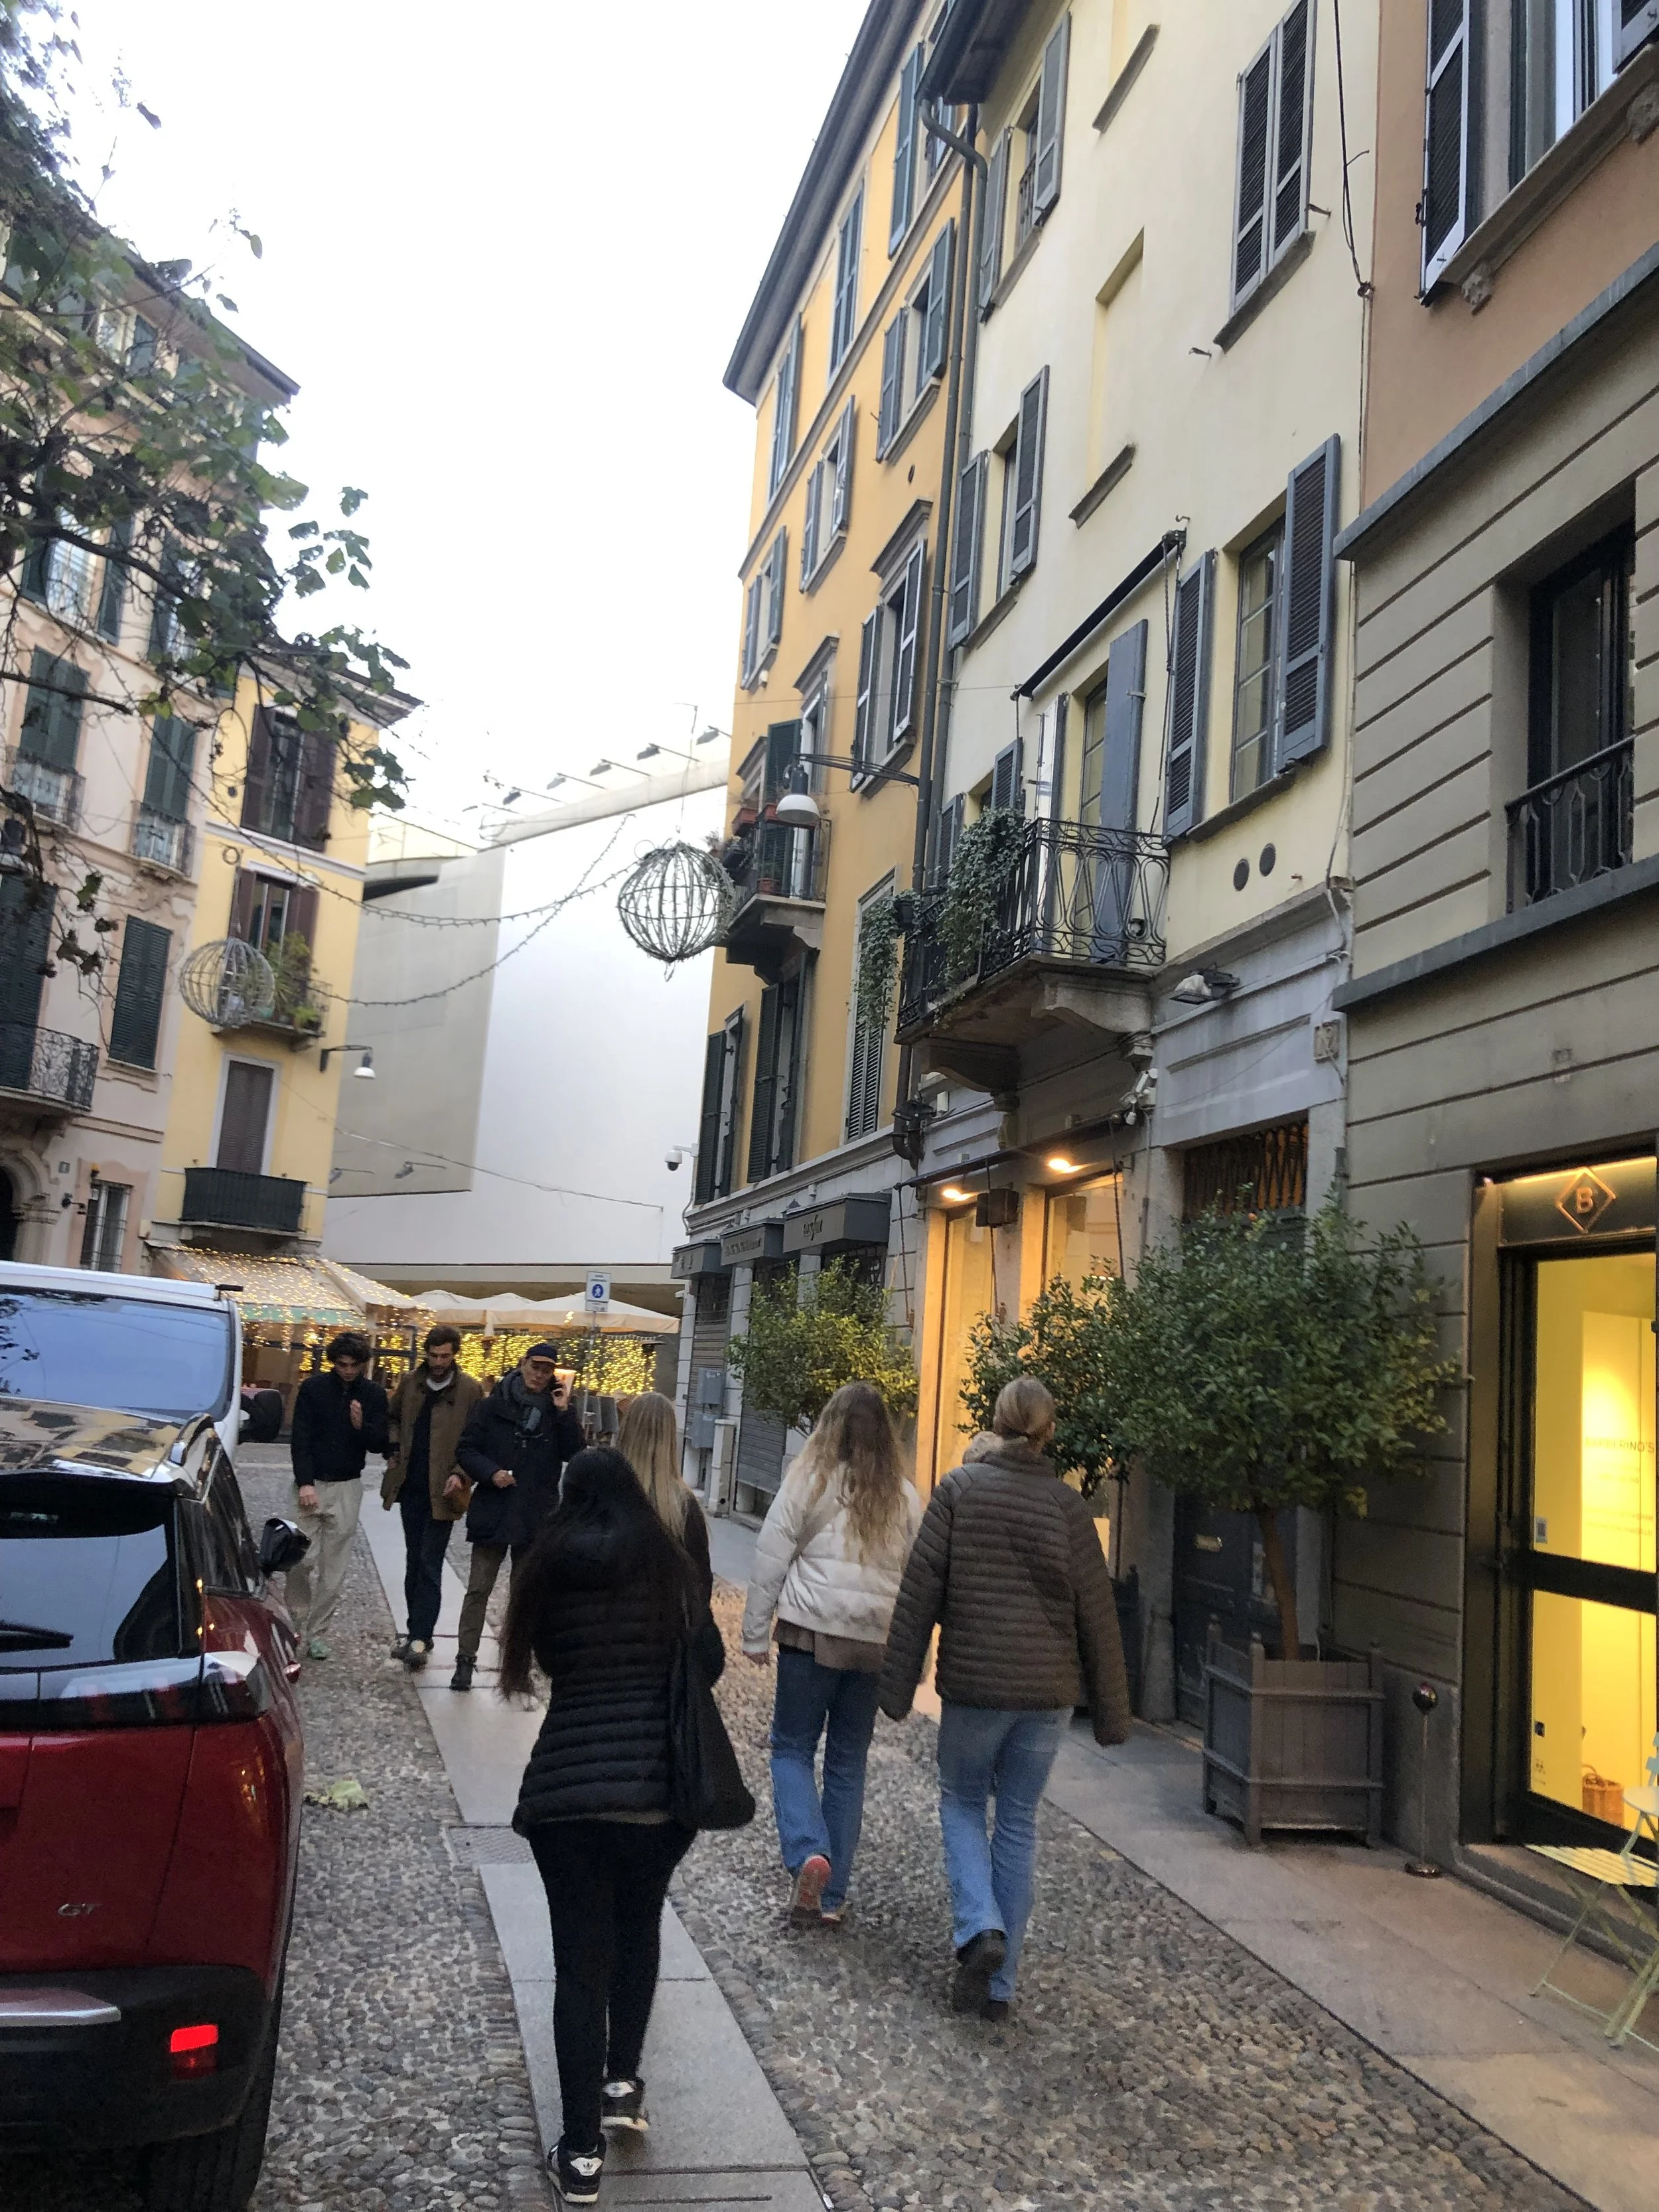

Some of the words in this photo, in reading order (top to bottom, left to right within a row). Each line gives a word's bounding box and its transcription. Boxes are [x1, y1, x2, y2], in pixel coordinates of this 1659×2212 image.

[1577, 1187, 1593, 1214] B
[1585, 1436, 1655, 1453] RINO'S
[57, 1903, 103, 1917] GT
